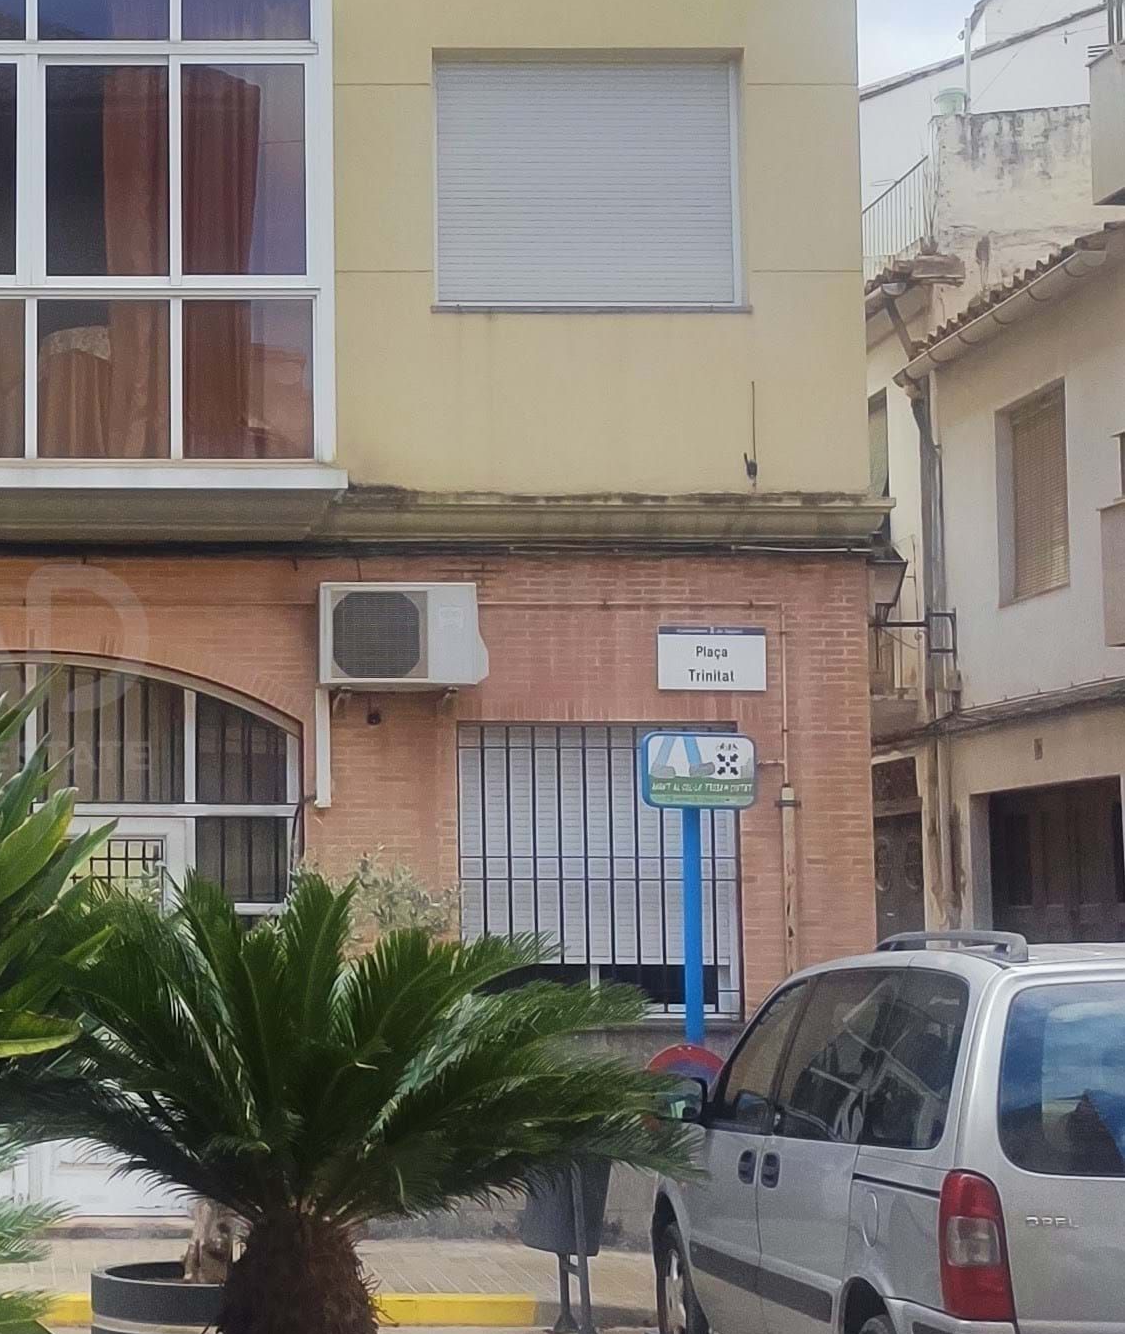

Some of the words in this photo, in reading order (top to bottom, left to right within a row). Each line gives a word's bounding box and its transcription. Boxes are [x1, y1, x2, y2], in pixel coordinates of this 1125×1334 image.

[695, 645, 728, 660] Plaça
[688, 668, 735, 682] Trinitat
[1025, 1215, 1080, 1229] OPEL
